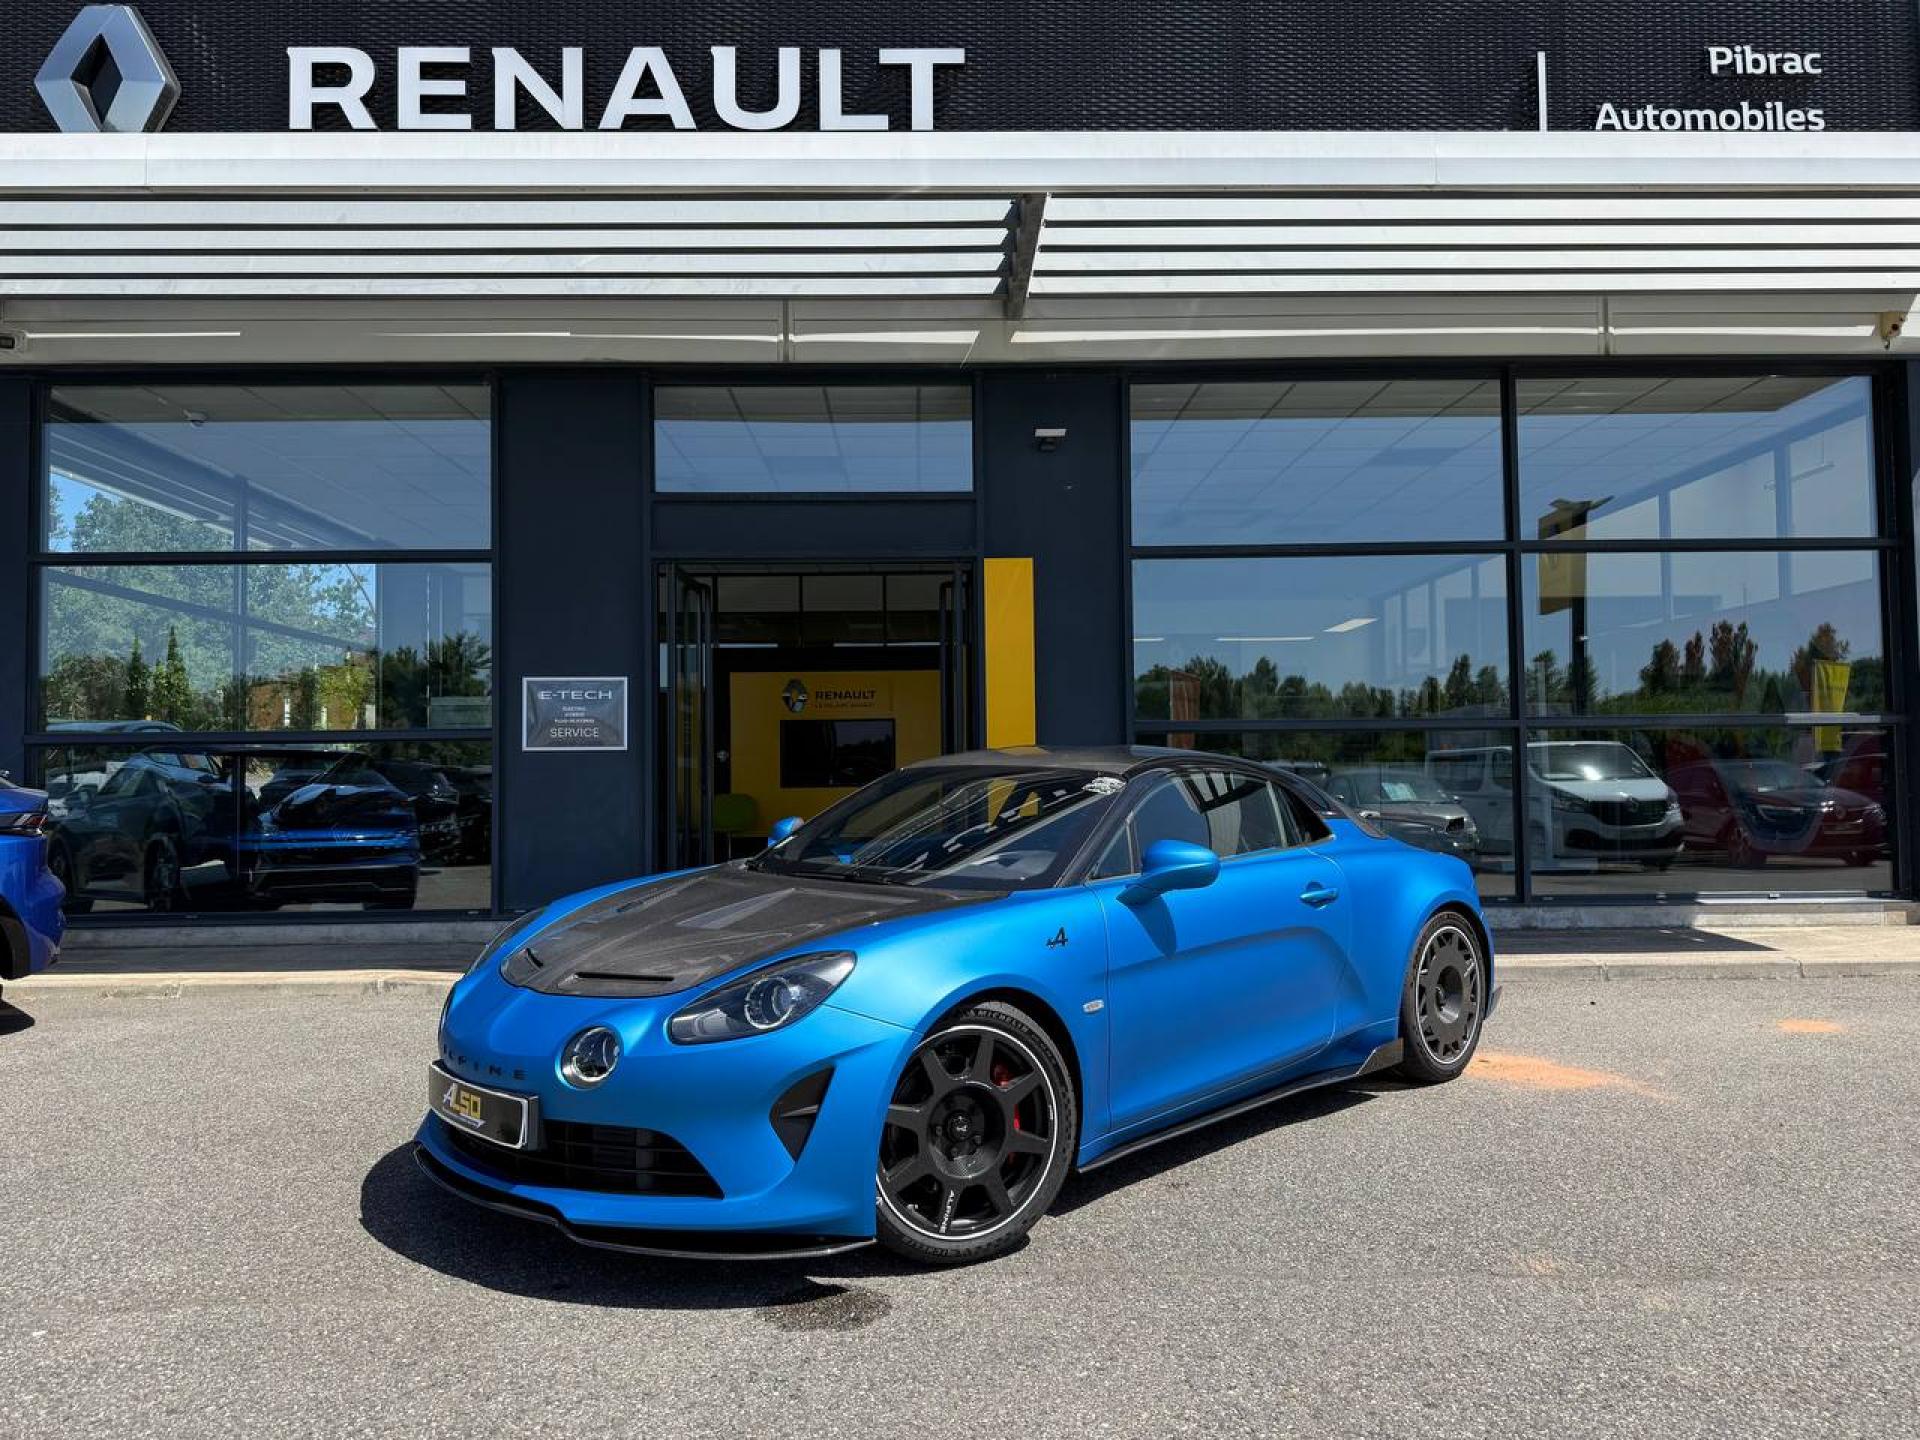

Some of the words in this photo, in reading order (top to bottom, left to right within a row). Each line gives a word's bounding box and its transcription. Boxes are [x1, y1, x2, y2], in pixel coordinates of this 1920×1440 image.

[1707, 45, 1822, 74] Pibrac
[287, 46, 966, 131] RENAULT
[1595, 101, 1826, 130] Automobiles
[539, 690, 612, 700] E-TECH
[815, 690, 877, 699] RENAULT
[550, 727, 600, 737] SERVICE
